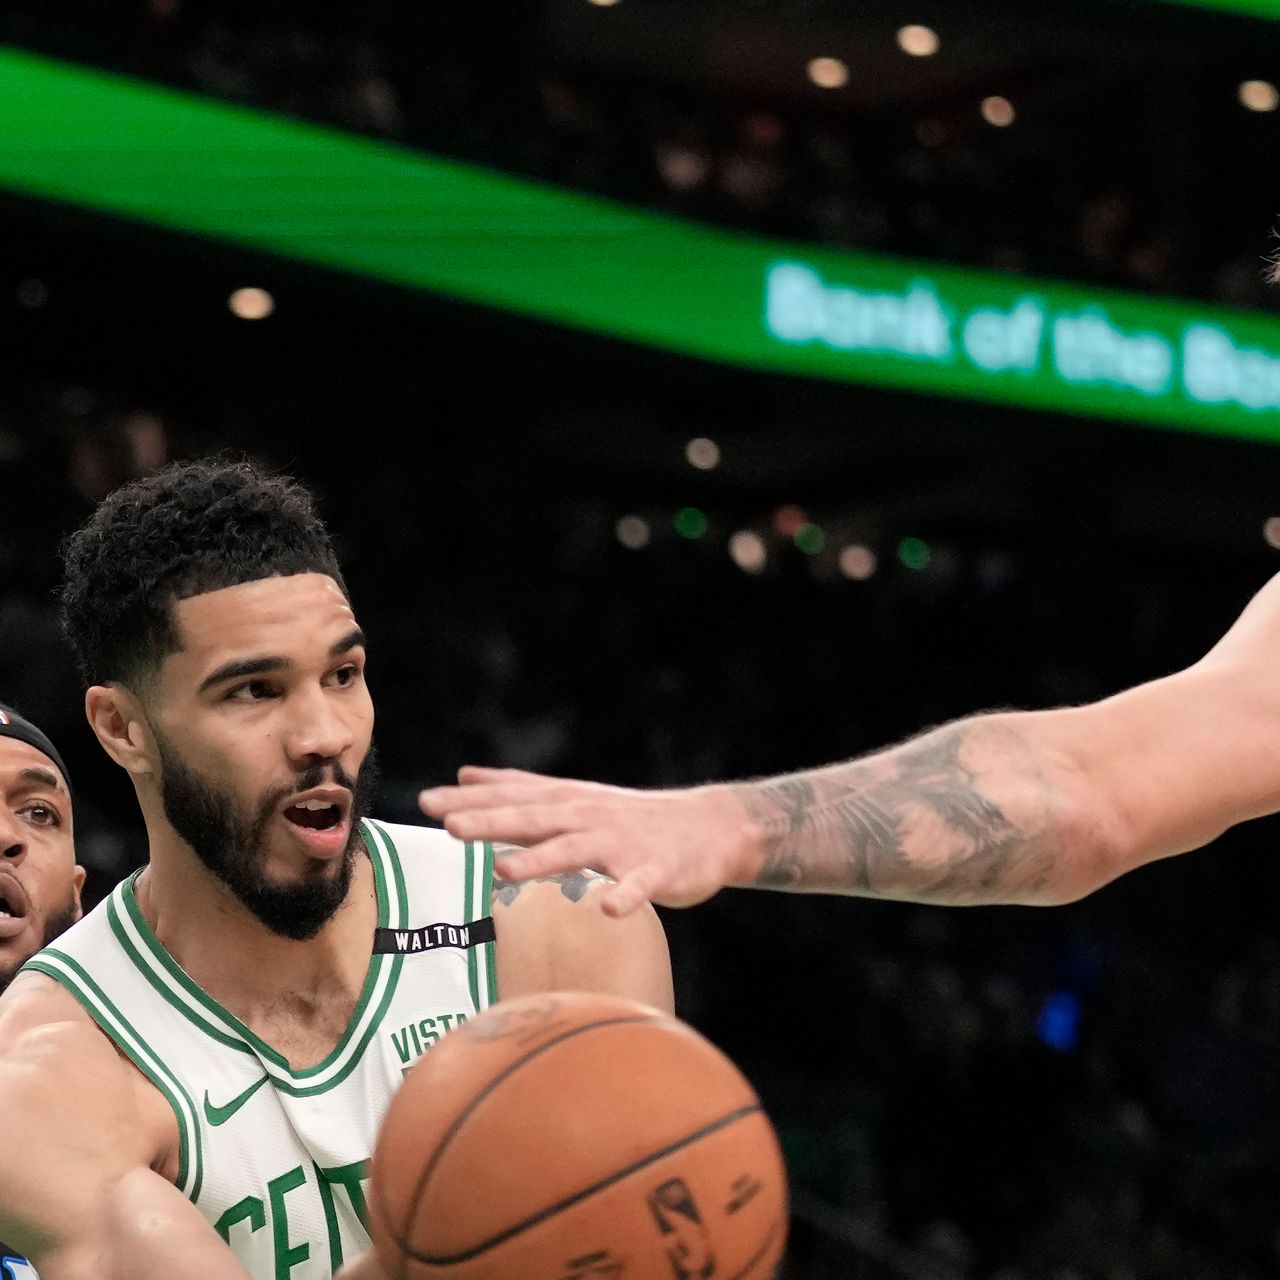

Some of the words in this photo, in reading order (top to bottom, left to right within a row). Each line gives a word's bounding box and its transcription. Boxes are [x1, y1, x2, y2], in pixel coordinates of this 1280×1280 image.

[767, 263, 952, 362] Bank
[963, 300, 1043, 374] of
[1053, 310, 1172, 396] the
[394, 926, 470, 951] WALTON
